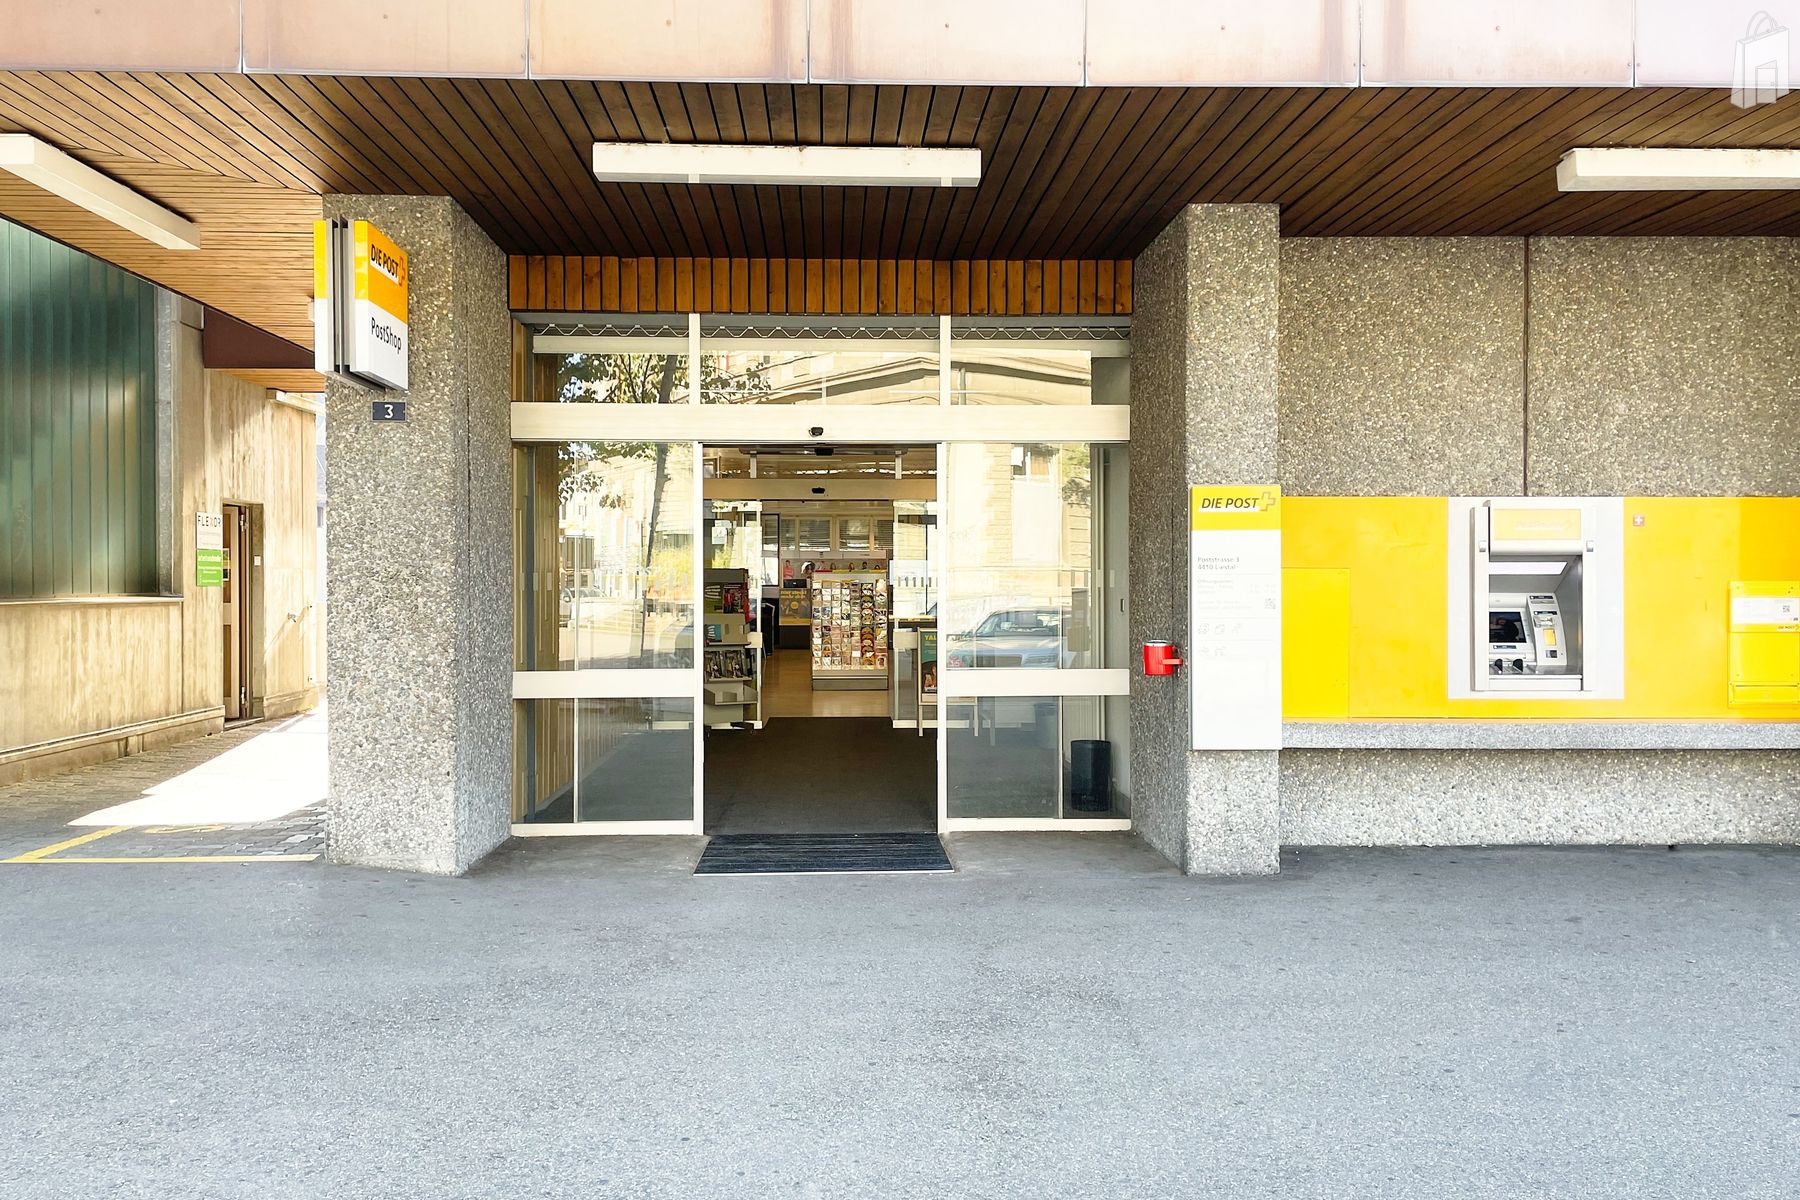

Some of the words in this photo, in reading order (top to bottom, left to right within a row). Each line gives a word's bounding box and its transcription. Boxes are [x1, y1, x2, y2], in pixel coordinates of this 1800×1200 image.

[371, 244, 382, 266] DIE
[383, 254, 399, 278] POST
[371, 317, 402, 355] PostShop
[384, 404, 394, 419] 3
[1202, 498, 1222, 509] DIE
[1225, 498, 1259, 509] POST
